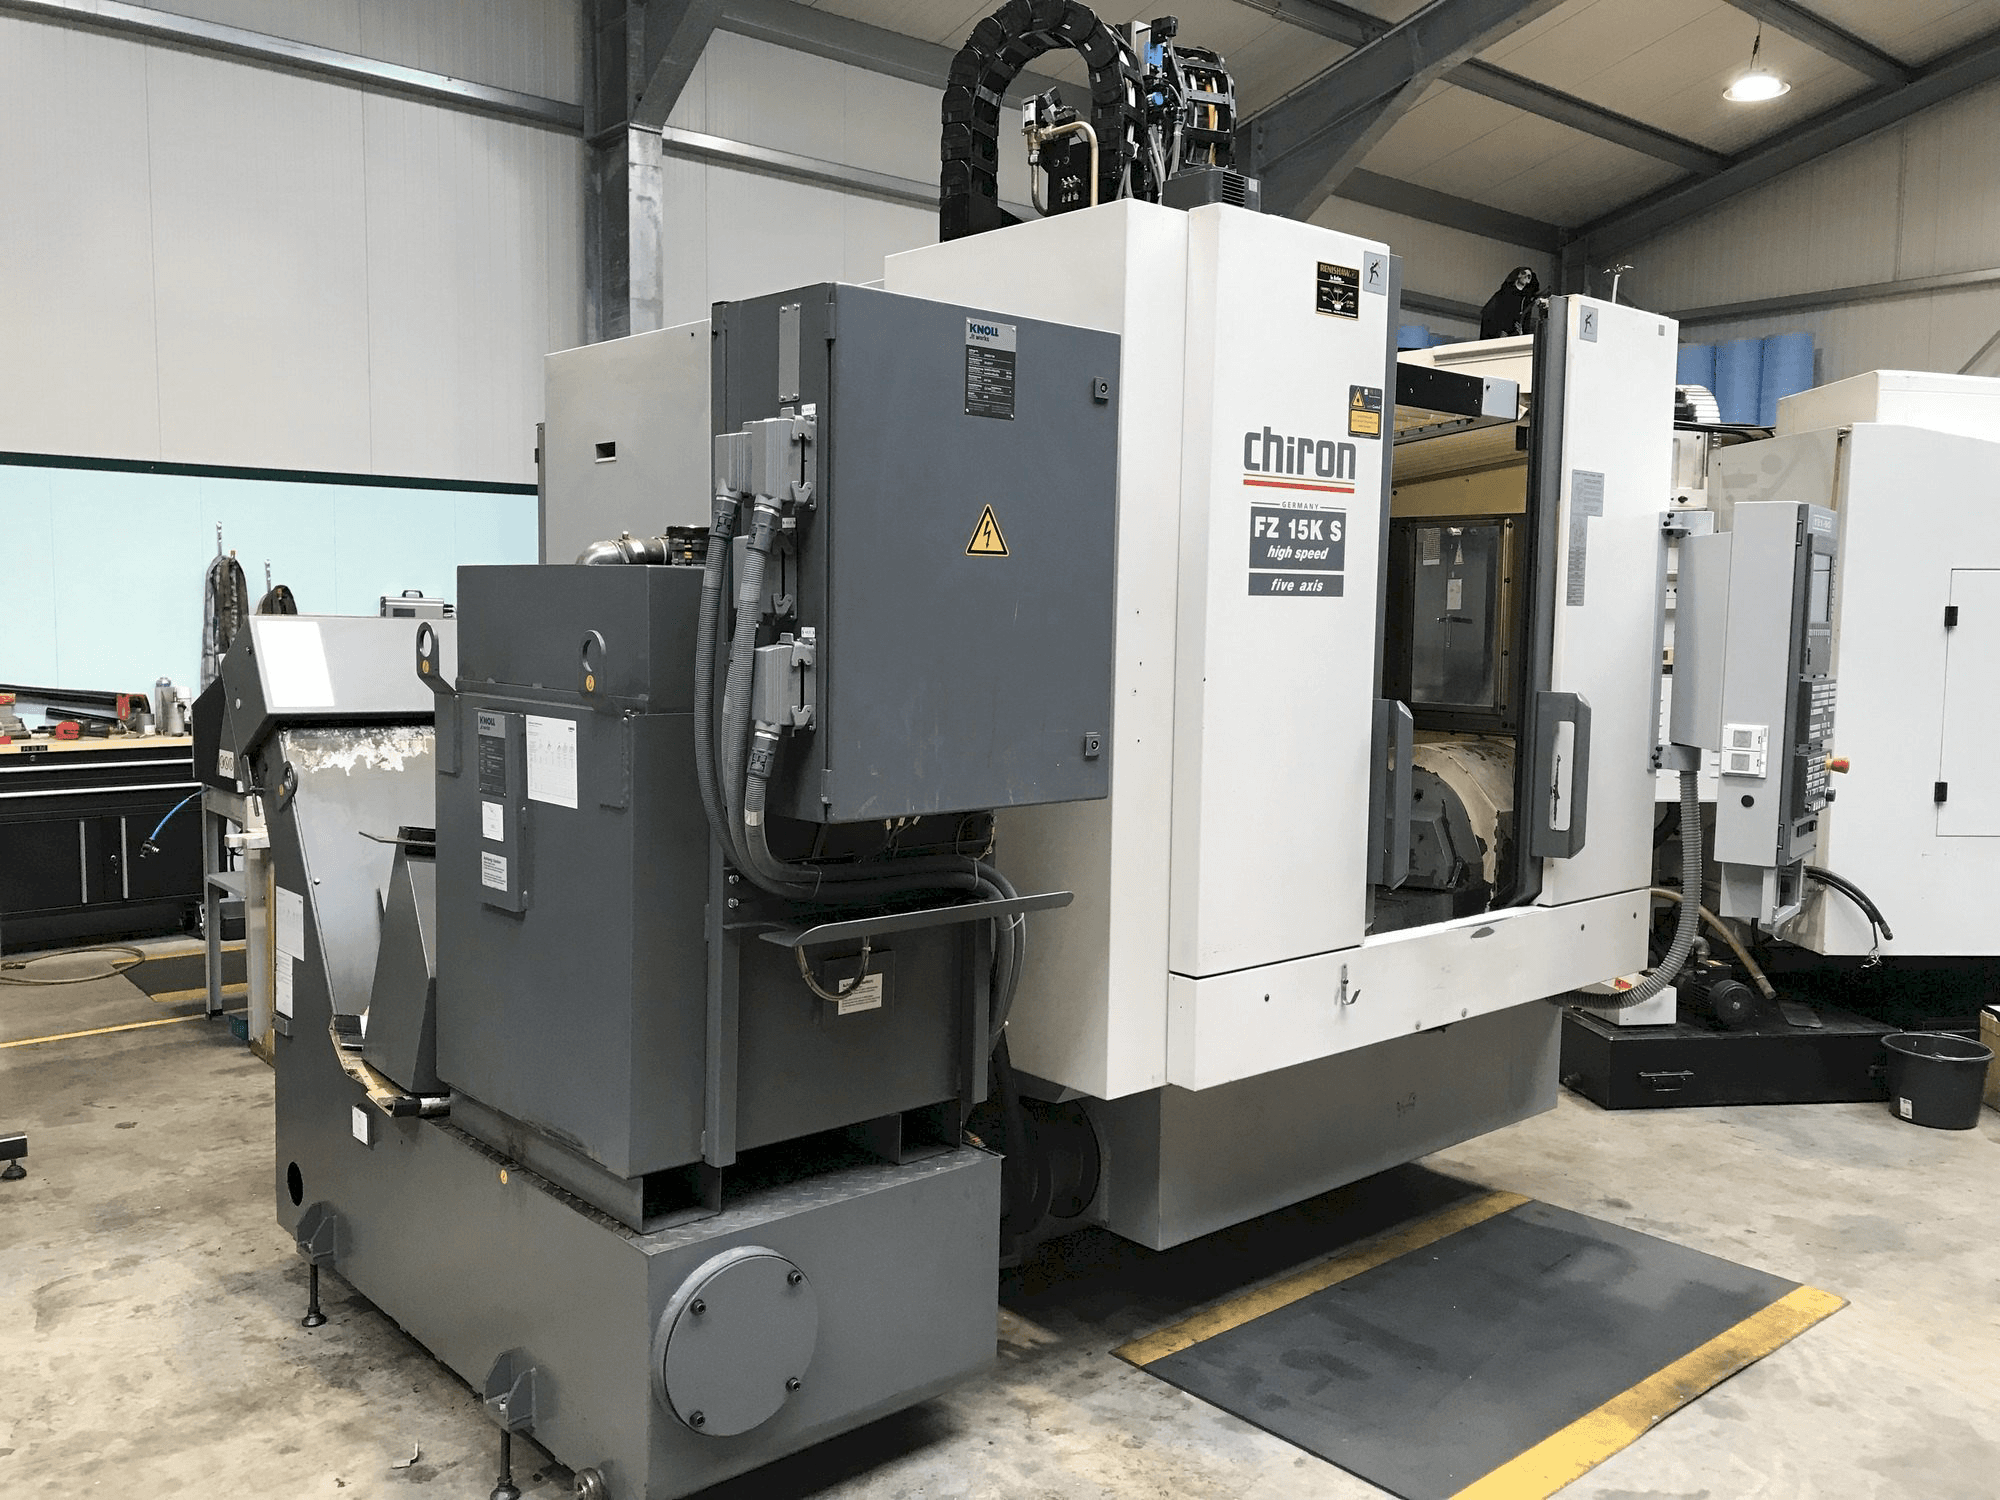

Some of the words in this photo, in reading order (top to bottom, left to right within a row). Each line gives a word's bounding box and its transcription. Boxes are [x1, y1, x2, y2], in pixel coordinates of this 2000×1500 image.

[969, 323, 999, 337] KNOLL
[1244, 426, 1356, 479] chiron
[1282, 501, 1319, 510] GERMANY
[1254, 516, 1279, 539] FZ
[1288, 518, 1323, 541] 15K
[1330, 520, 1342, 542] S
[1267, 545, 1293, 561] high
[1294, 547, 1329, 562] speed
[1270, 578, 1294, 592] five
[1299, 579, 1324, 592] axis
[479, 715, 496, 727] KNOLL
